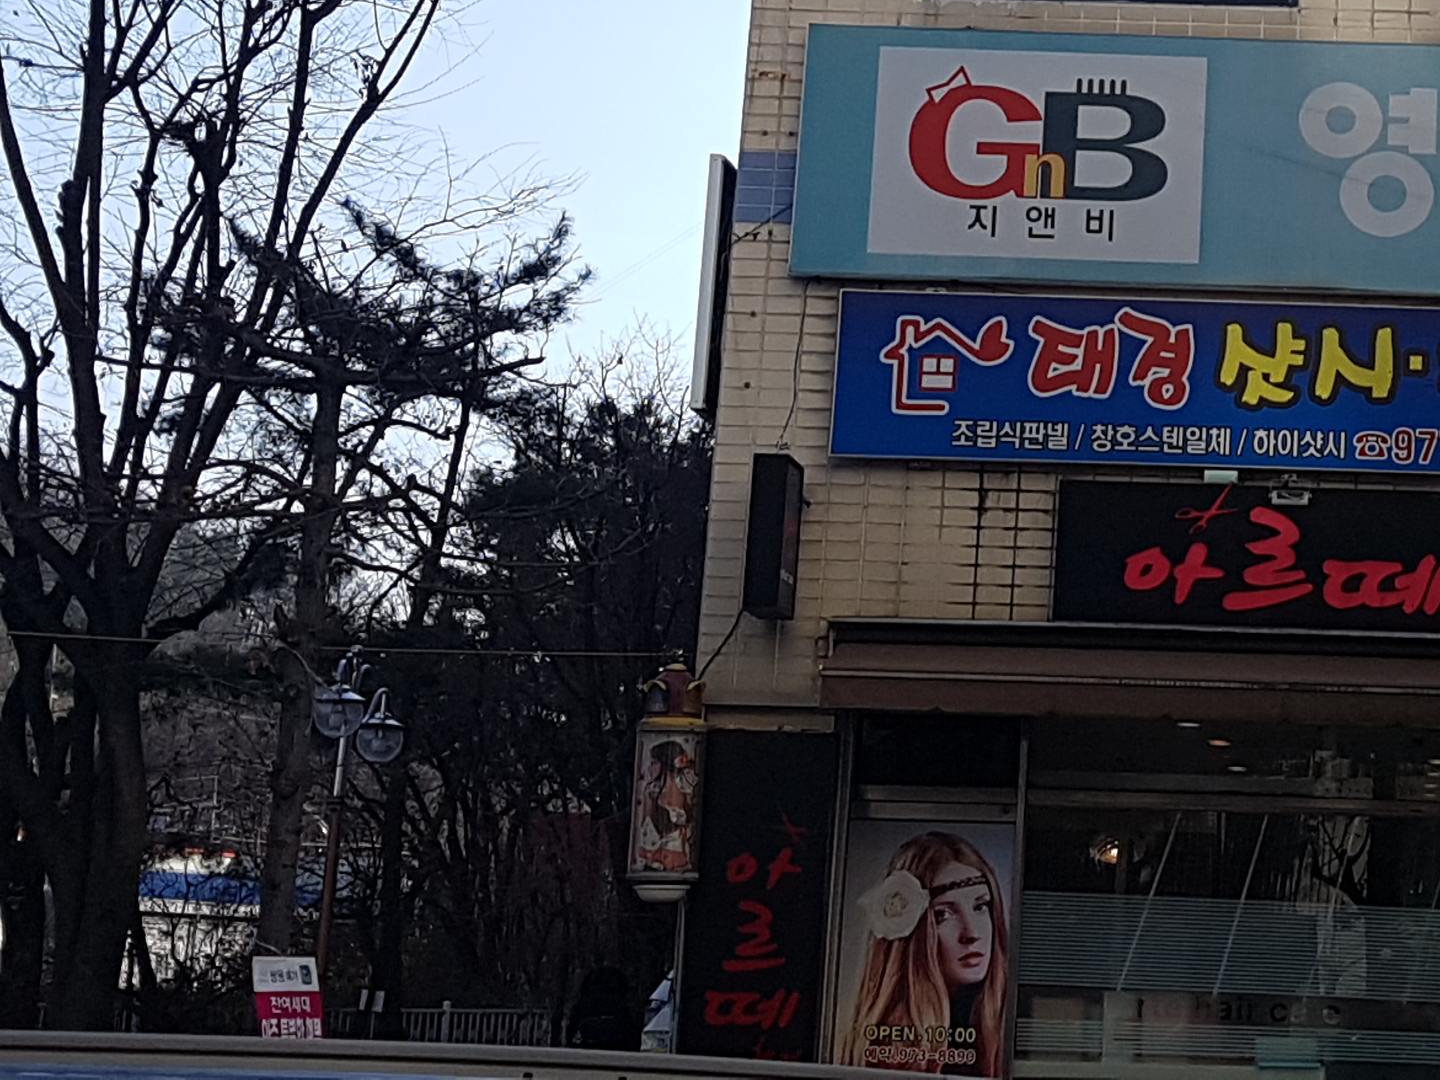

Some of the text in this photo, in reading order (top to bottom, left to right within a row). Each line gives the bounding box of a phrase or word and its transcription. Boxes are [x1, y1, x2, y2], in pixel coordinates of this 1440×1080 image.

[908, 66, 1168, 202] GnB
[966, 204, 1116, 242] 지앤비
[1028, 307, 1195, 409] 태경
[950, 419, 1069, 451] 조립식판넬
[1252, 428, 1346, 460] 하이샷시
